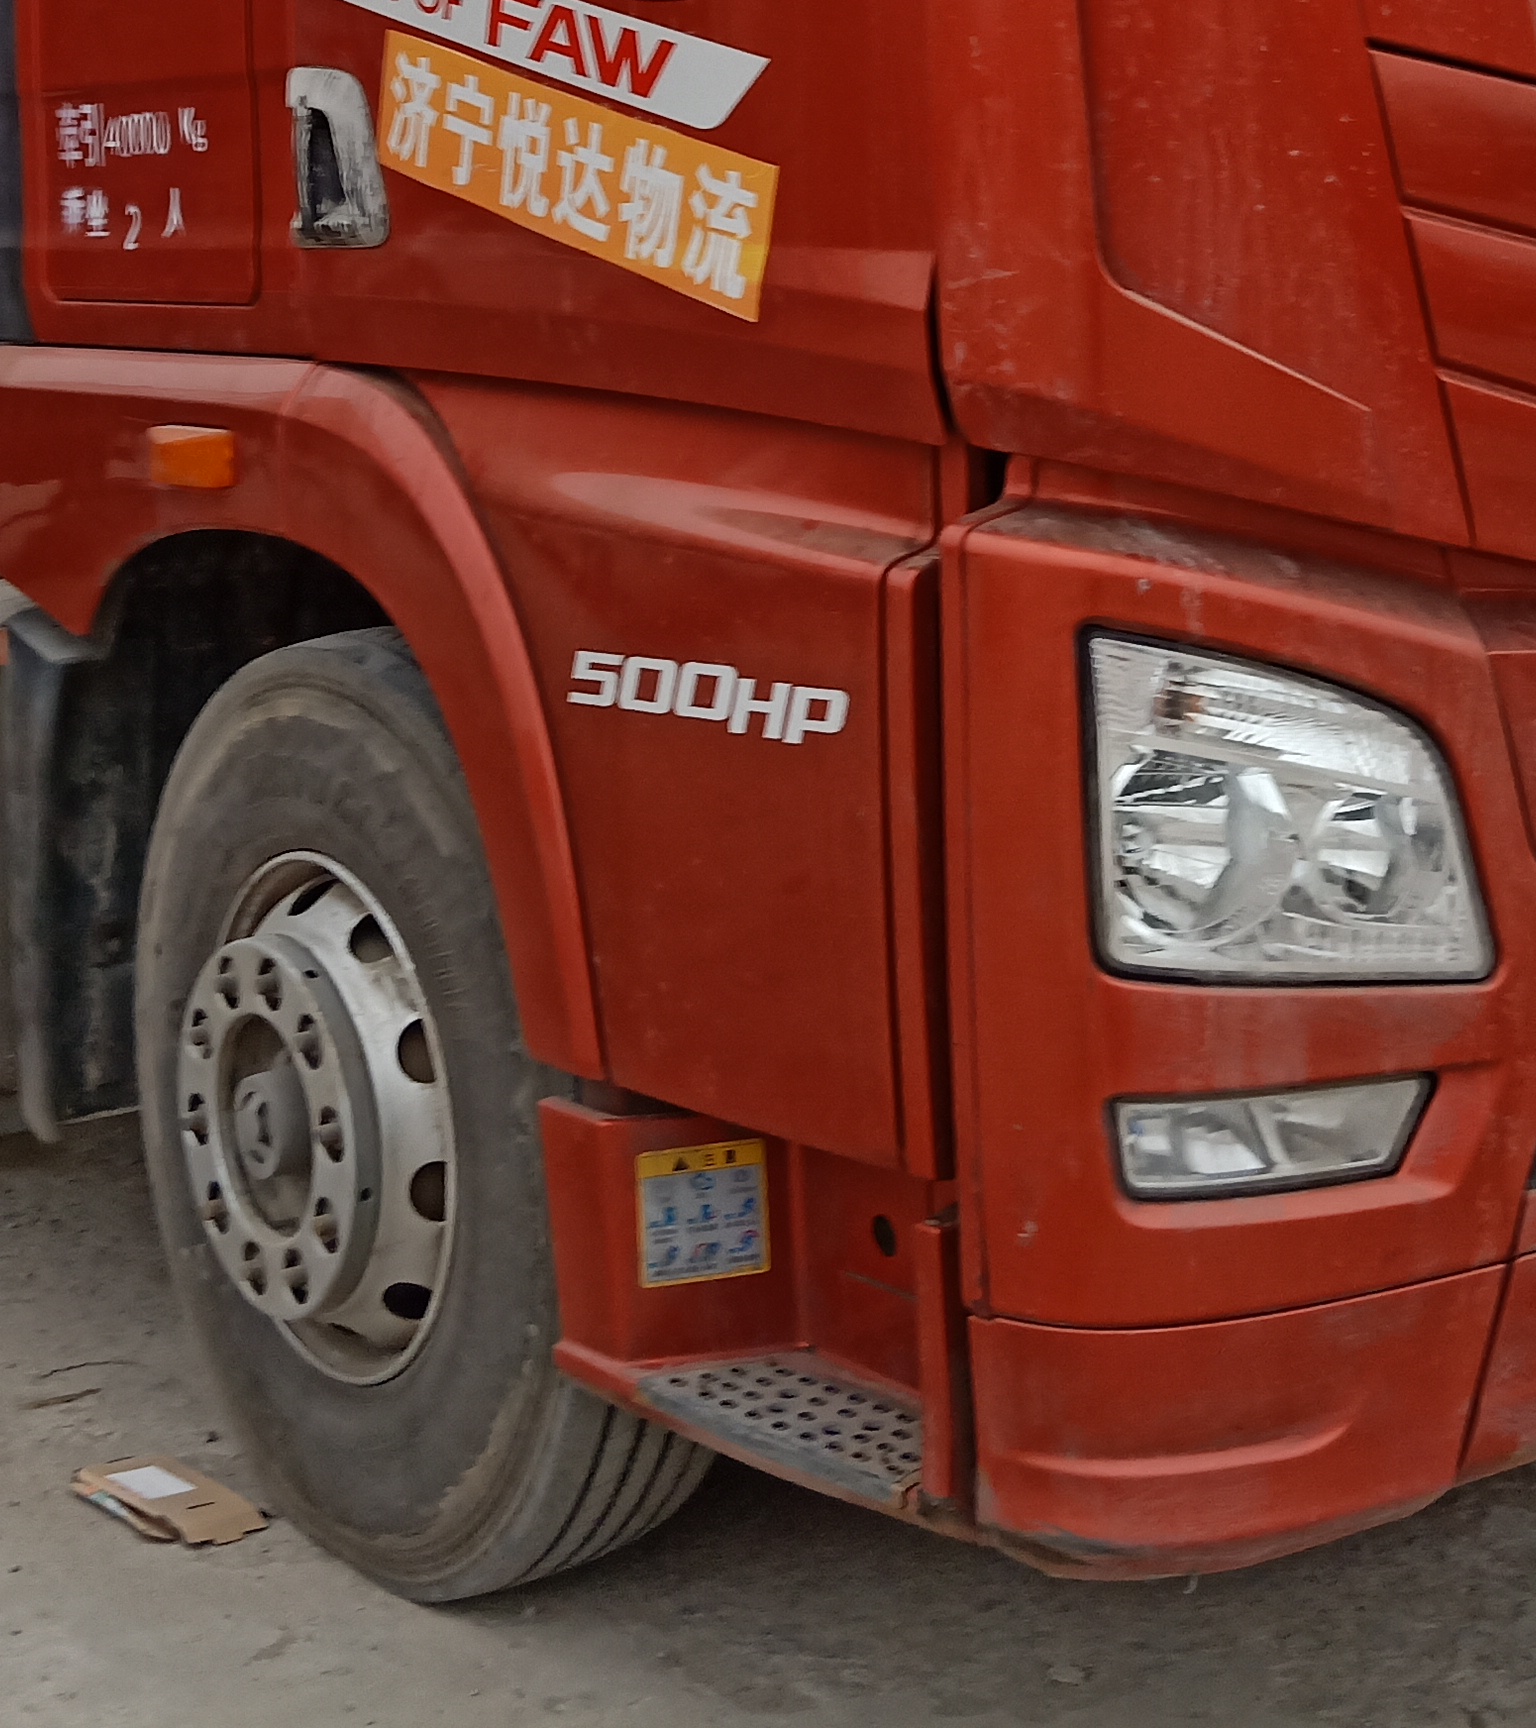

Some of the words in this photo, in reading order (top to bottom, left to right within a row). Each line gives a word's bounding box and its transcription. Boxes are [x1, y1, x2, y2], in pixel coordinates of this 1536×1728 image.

[123, 203, 142, 250] 2
[161, 188, 186, 238] 人
[387, 52, 759, 300] 济宁悦达物流
[567, 650, 850, 744] 500HP
